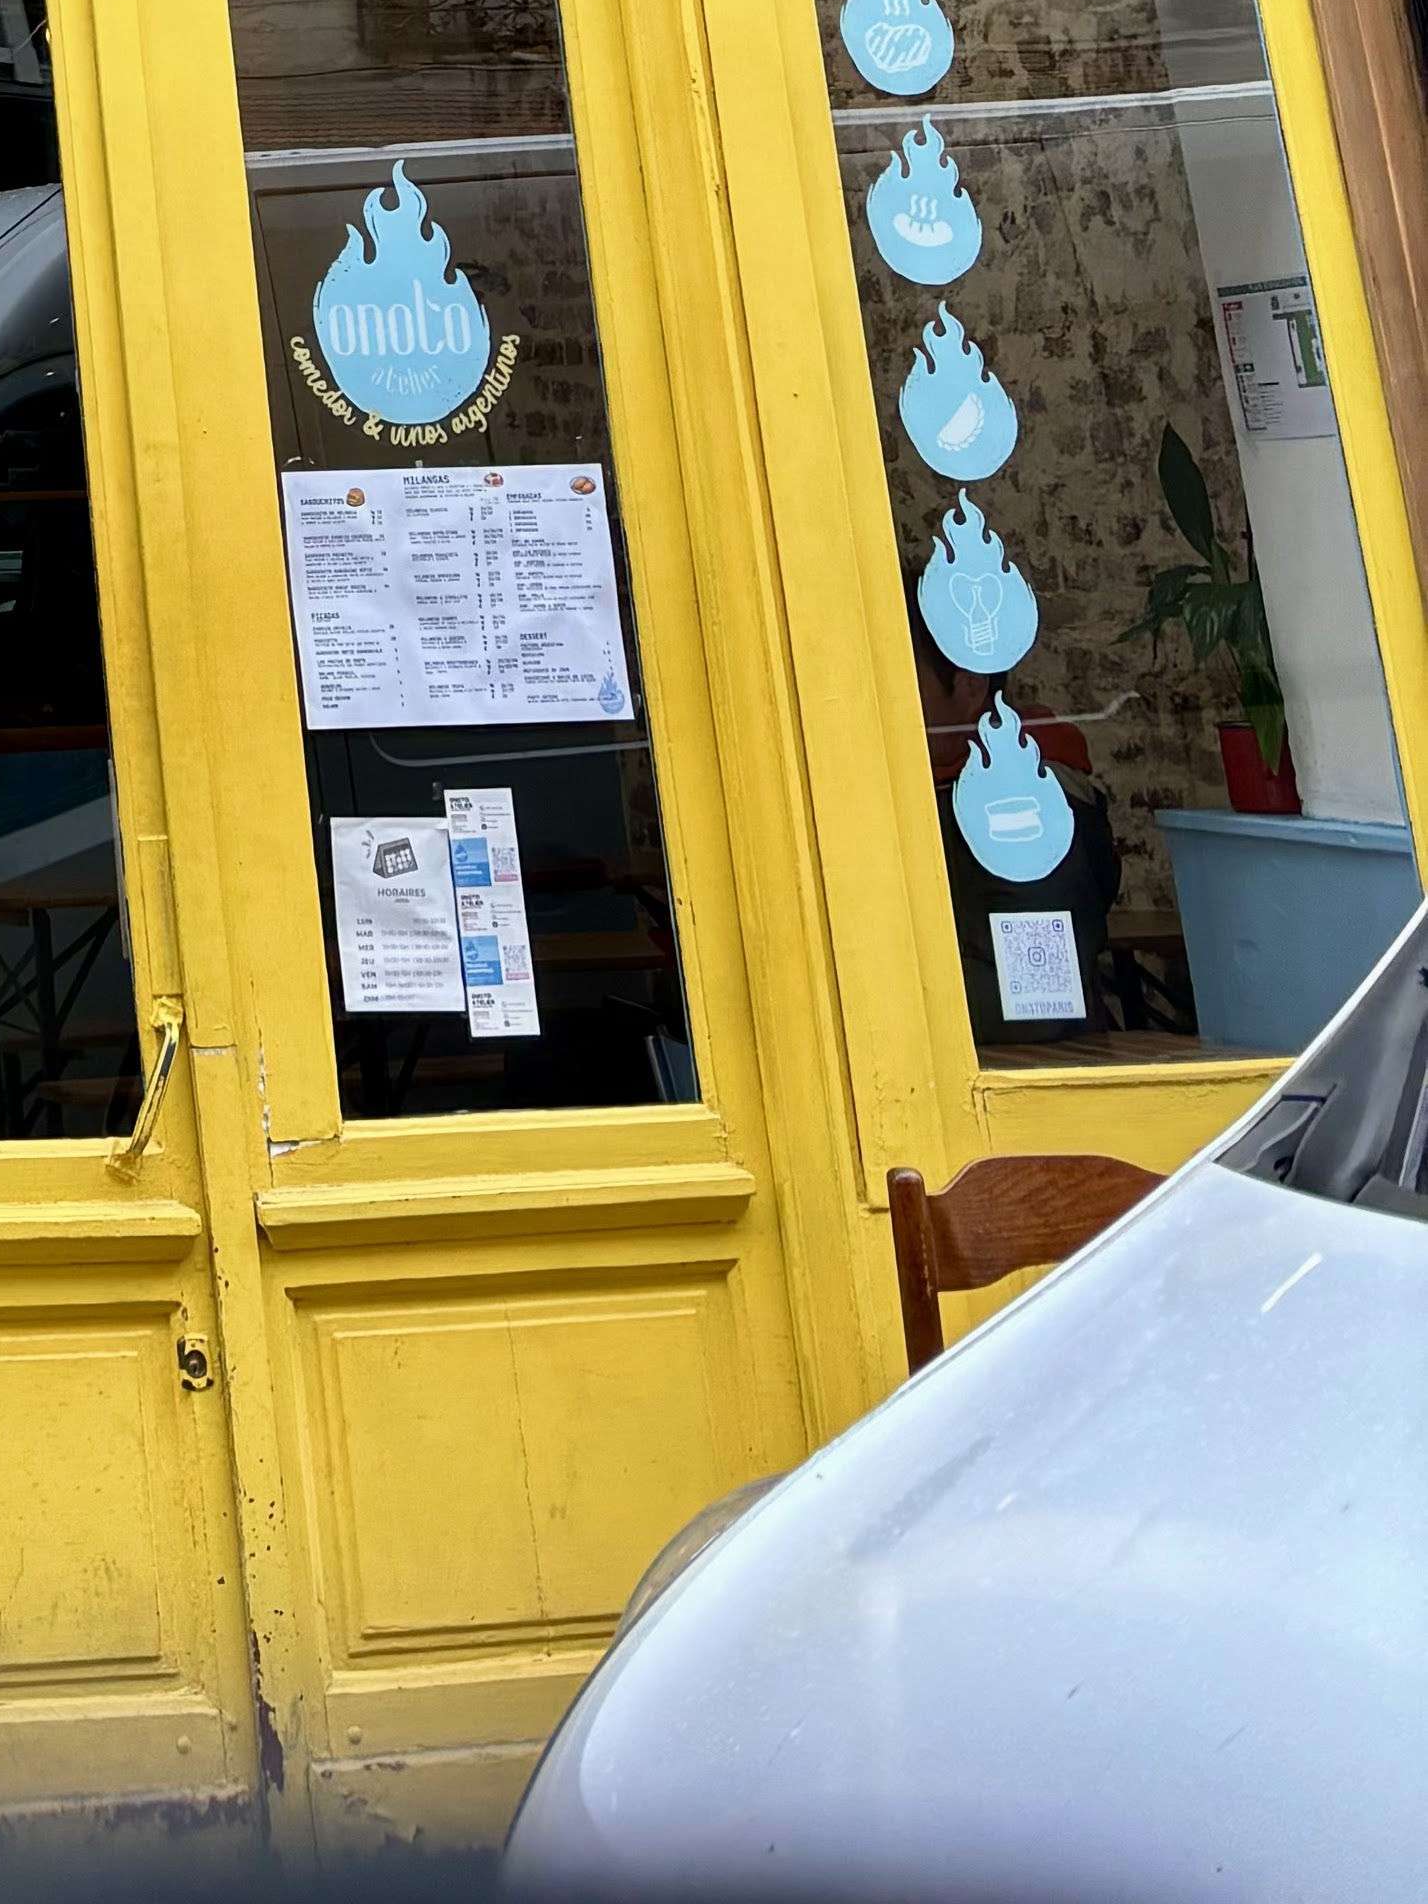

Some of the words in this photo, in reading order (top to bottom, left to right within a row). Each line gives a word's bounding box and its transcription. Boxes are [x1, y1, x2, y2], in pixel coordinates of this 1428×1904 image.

[327, 278, 472, 357] onoto
[290, 335, 356, 427] comedor
[361, 411, 382, 441] &
[390, 419, 449, 448] vinos
[451, 332, 521, 434] argentinos
[377, 888, 427, 898] HORAIRES
